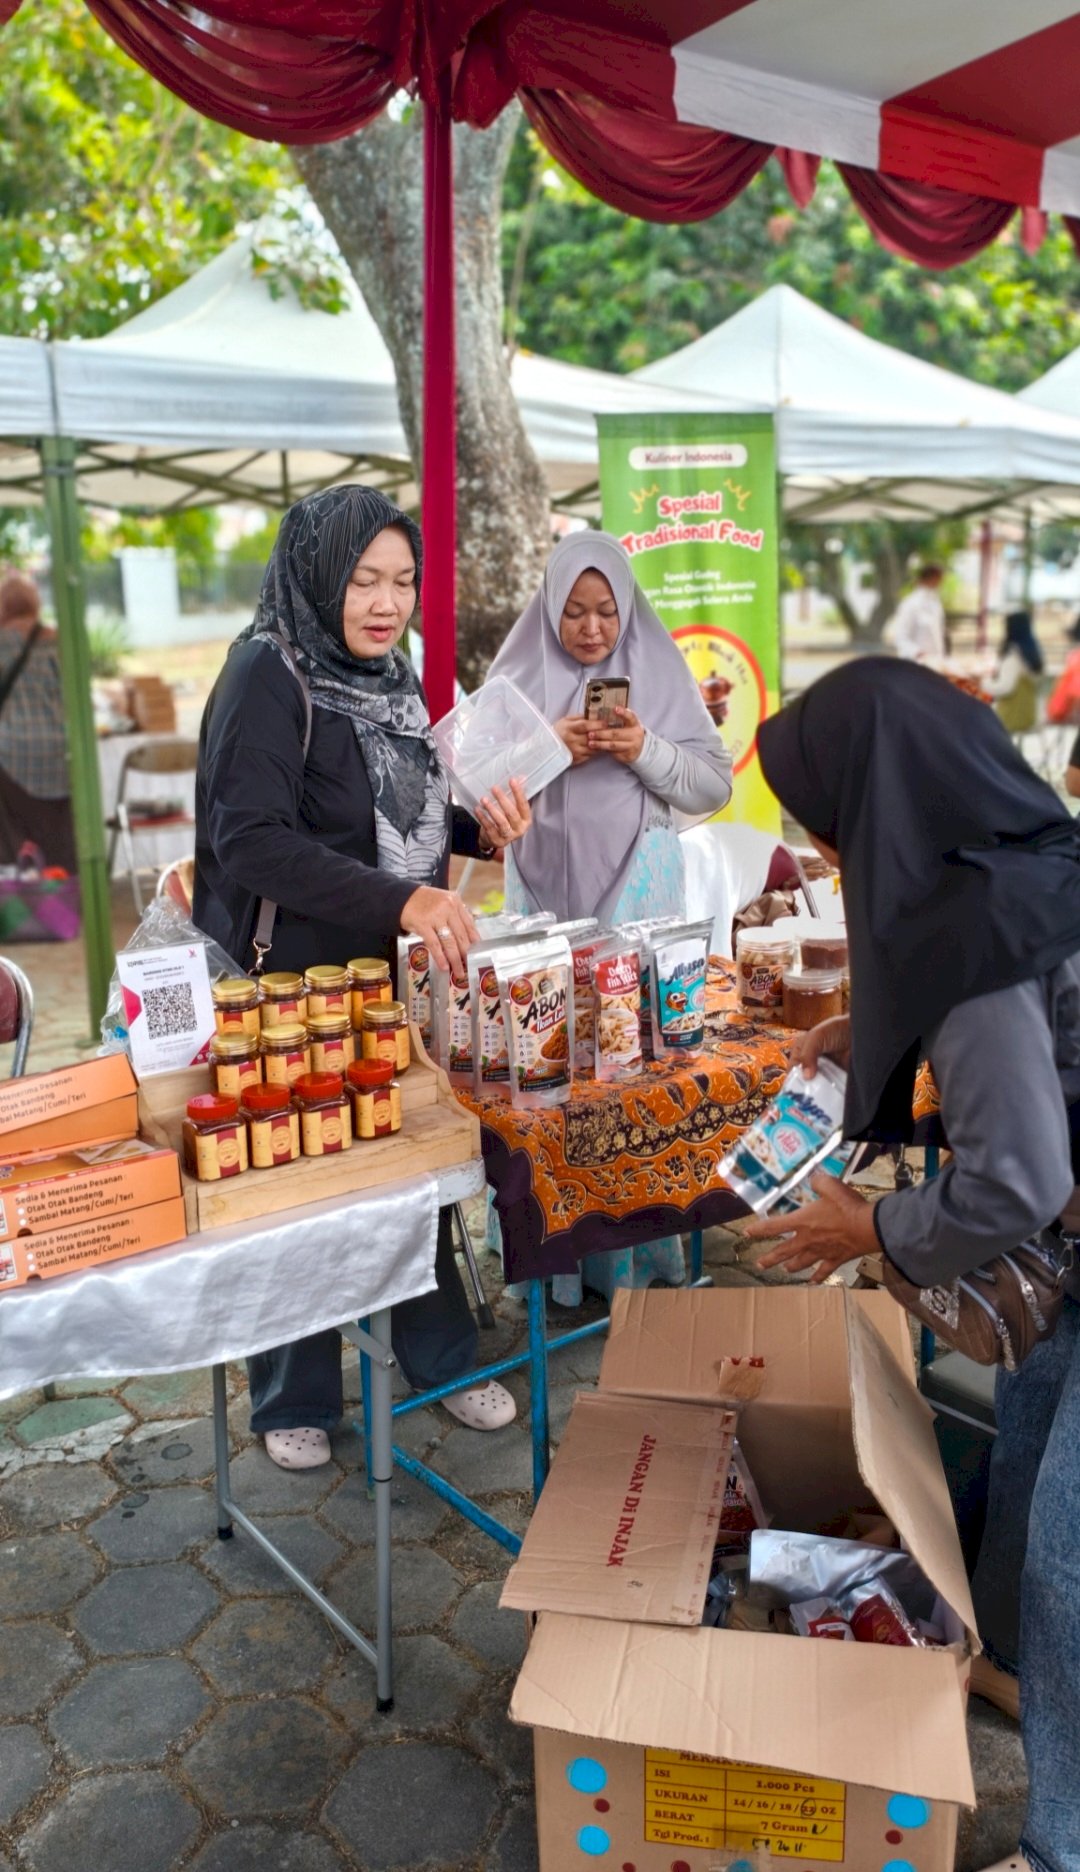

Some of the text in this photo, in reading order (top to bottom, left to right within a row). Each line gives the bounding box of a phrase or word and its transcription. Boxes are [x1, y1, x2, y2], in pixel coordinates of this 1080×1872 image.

[645, 450, 732, 463] Kuliner Indonesia
[658, 492, 721, 518] Spesial
[620, 521, 762, 554] Tradisional Food
[15, 1193, 38, 1205] Sedia
[48, 1182, 88, 1197] Menerima
[89, 1174, 123, 1188] Pesanan
[27, 1190, 104, 1213] Otak Otak Bandeng
[24, 1238, 47, 1250] Sedia
[56, 1227, 96, 1243] Menerima
[97, 1218, 130, 1231] Pesanan
[36, 1234, 111, 1259] Otak Otak Bandeng
[628, 1434, 657, 1493] JANGAN
[606, 1516, 635, 1568] INJAK
[654, 1768, 671, 1778] ISI
[654, 1789, 708, 1802] UKURAN
[756, 1780, 815, 1793] 1.000 Pcs
[654, 1809, 695, 1821] BERAT
[653, 1829, 670, 1840] Tgl
[760, 1821, 808, 1833] 7 Gram
